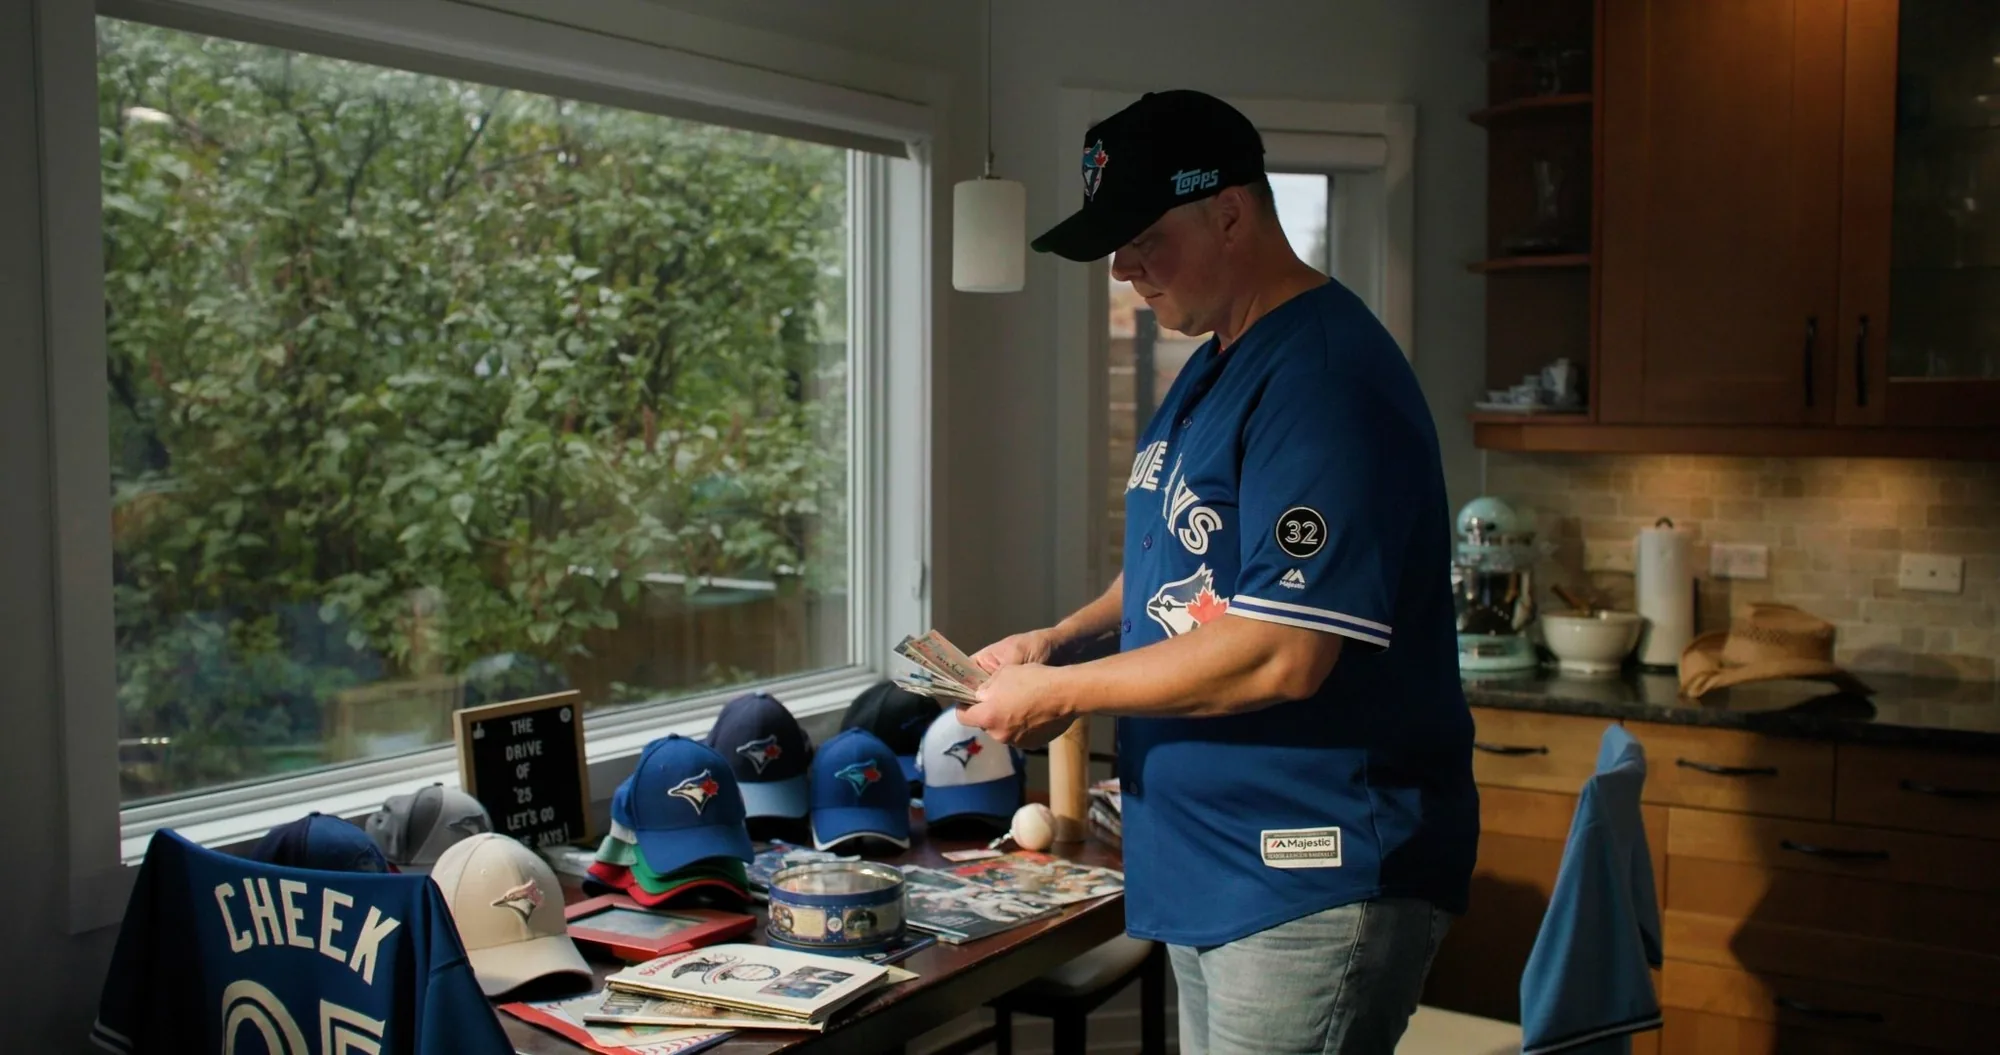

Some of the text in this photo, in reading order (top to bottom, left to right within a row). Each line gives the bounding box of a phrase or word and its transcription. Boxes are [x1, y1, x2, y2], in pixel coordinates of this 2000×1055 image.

[1125, 440, 1168, 495] UE
[1285, 520, 1318, 545] 32
[510, 718, 534, 735] THE
[505, 740, 543, 762] DRIVE
[515, 762, 531, 780] OF
[506, 806, 555, 830] LET'S GO
[1287, 838, 1331, 849] Majestic
[214, 877, 401, 986] CHEEK
